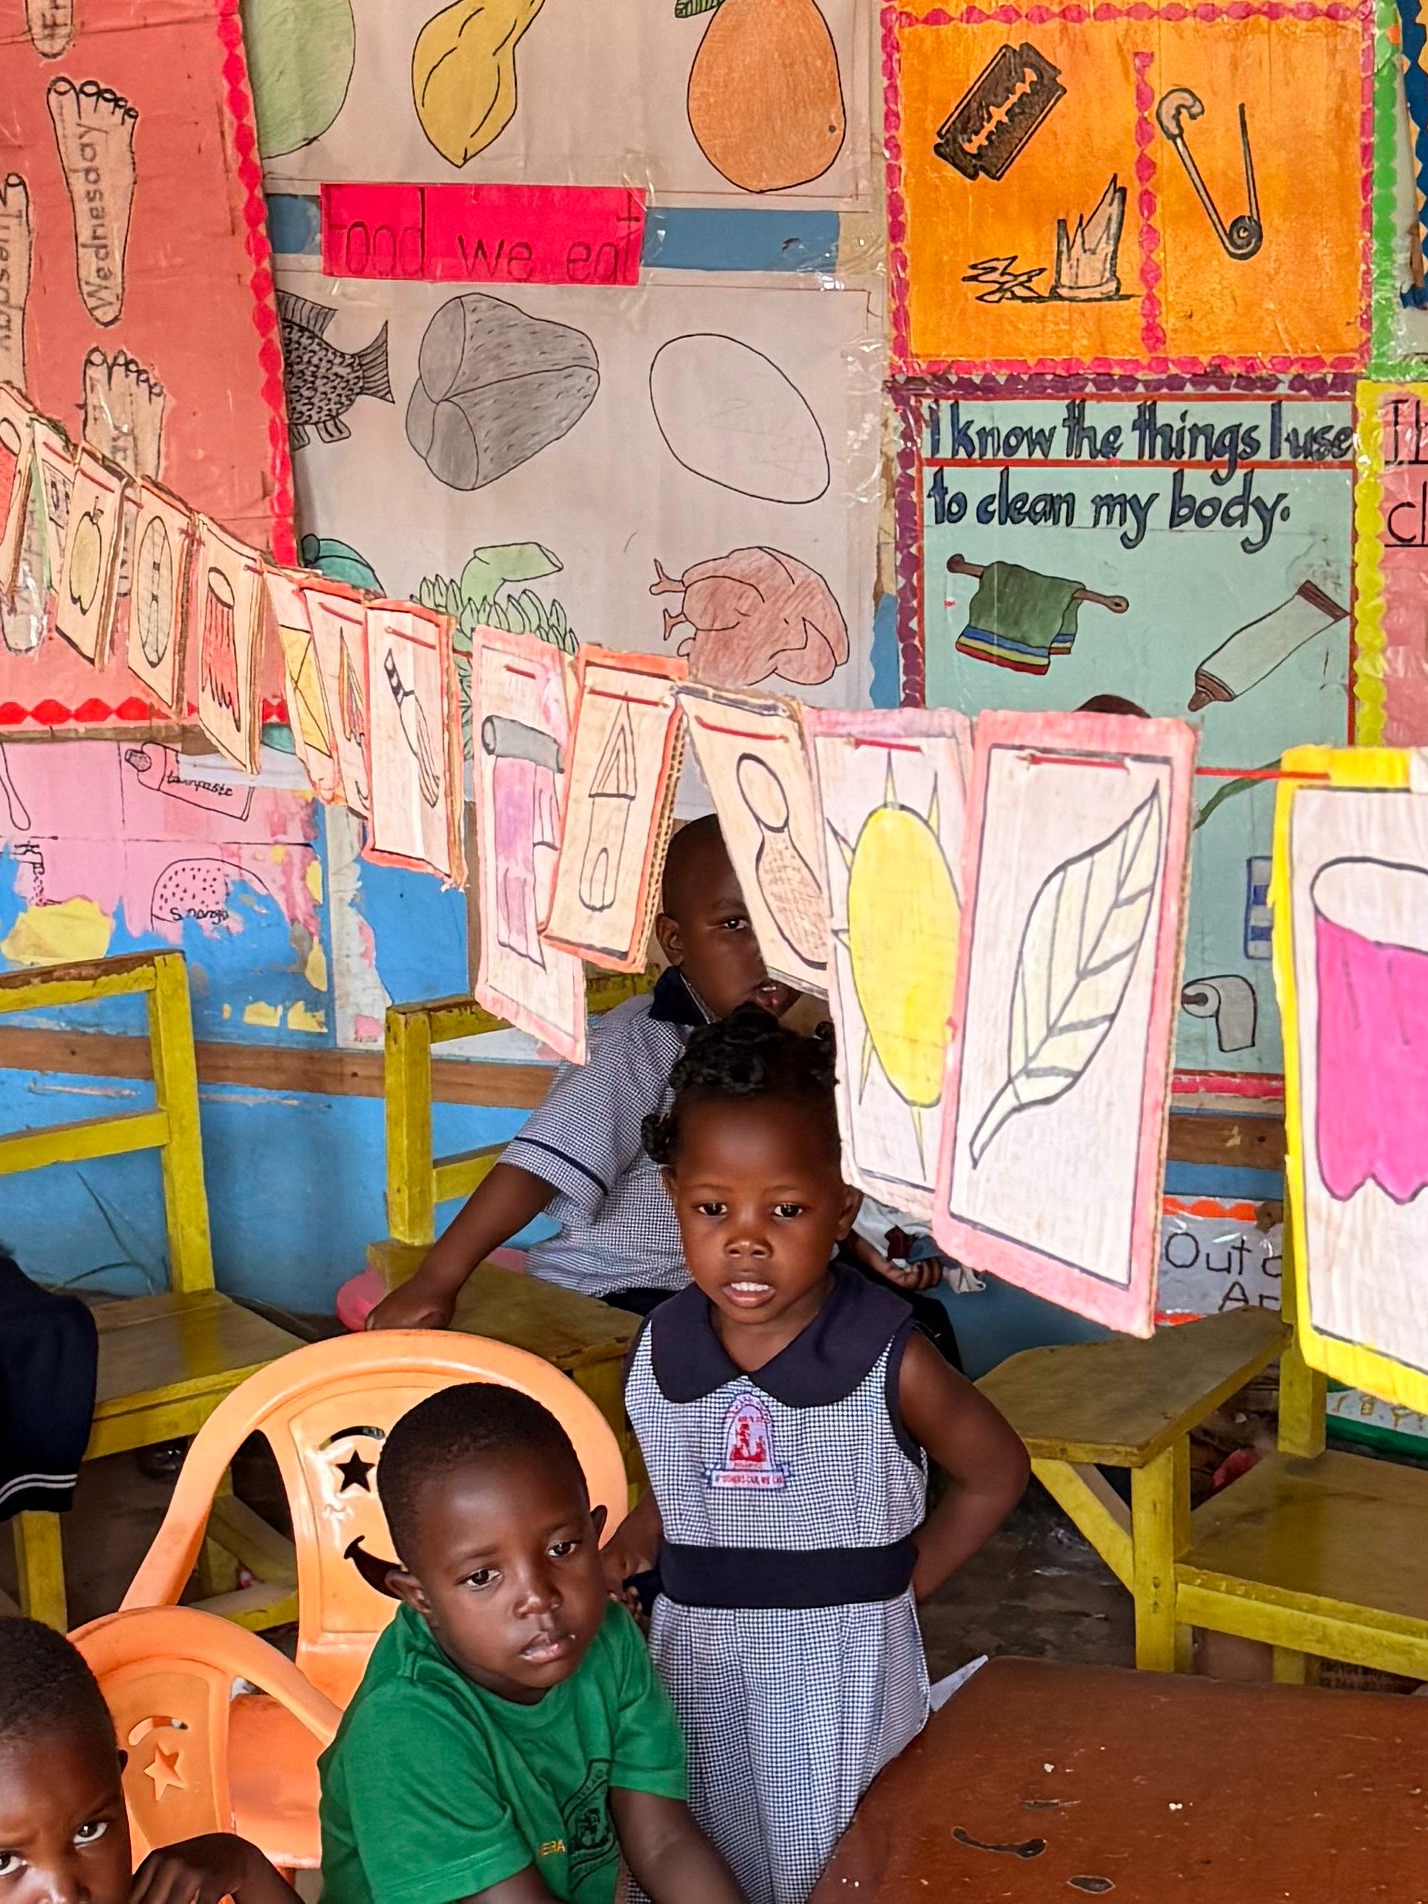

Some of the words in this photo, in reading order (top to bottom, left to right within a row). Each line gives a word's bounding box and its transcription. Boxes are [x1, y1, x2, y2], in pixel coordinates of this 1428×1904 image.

[69, 122, 121, 313] Wednesday
[457, 234, 534, 282] we
[566, 191, 640, 284] eat
[950, 399, 1056, 460] know
[1063, 399, 1124, 460] the
[1131, 399, 1261, 486] things
[1286, 423, 1355, 460] use
[927, 466, 967, 525] to
[975, 466, 1076, 527] clean
[1091, 491, 1161, 550] my
[1169, 467, 1291, 555] body.
[1165, 1232, 1252, 1275] Out
